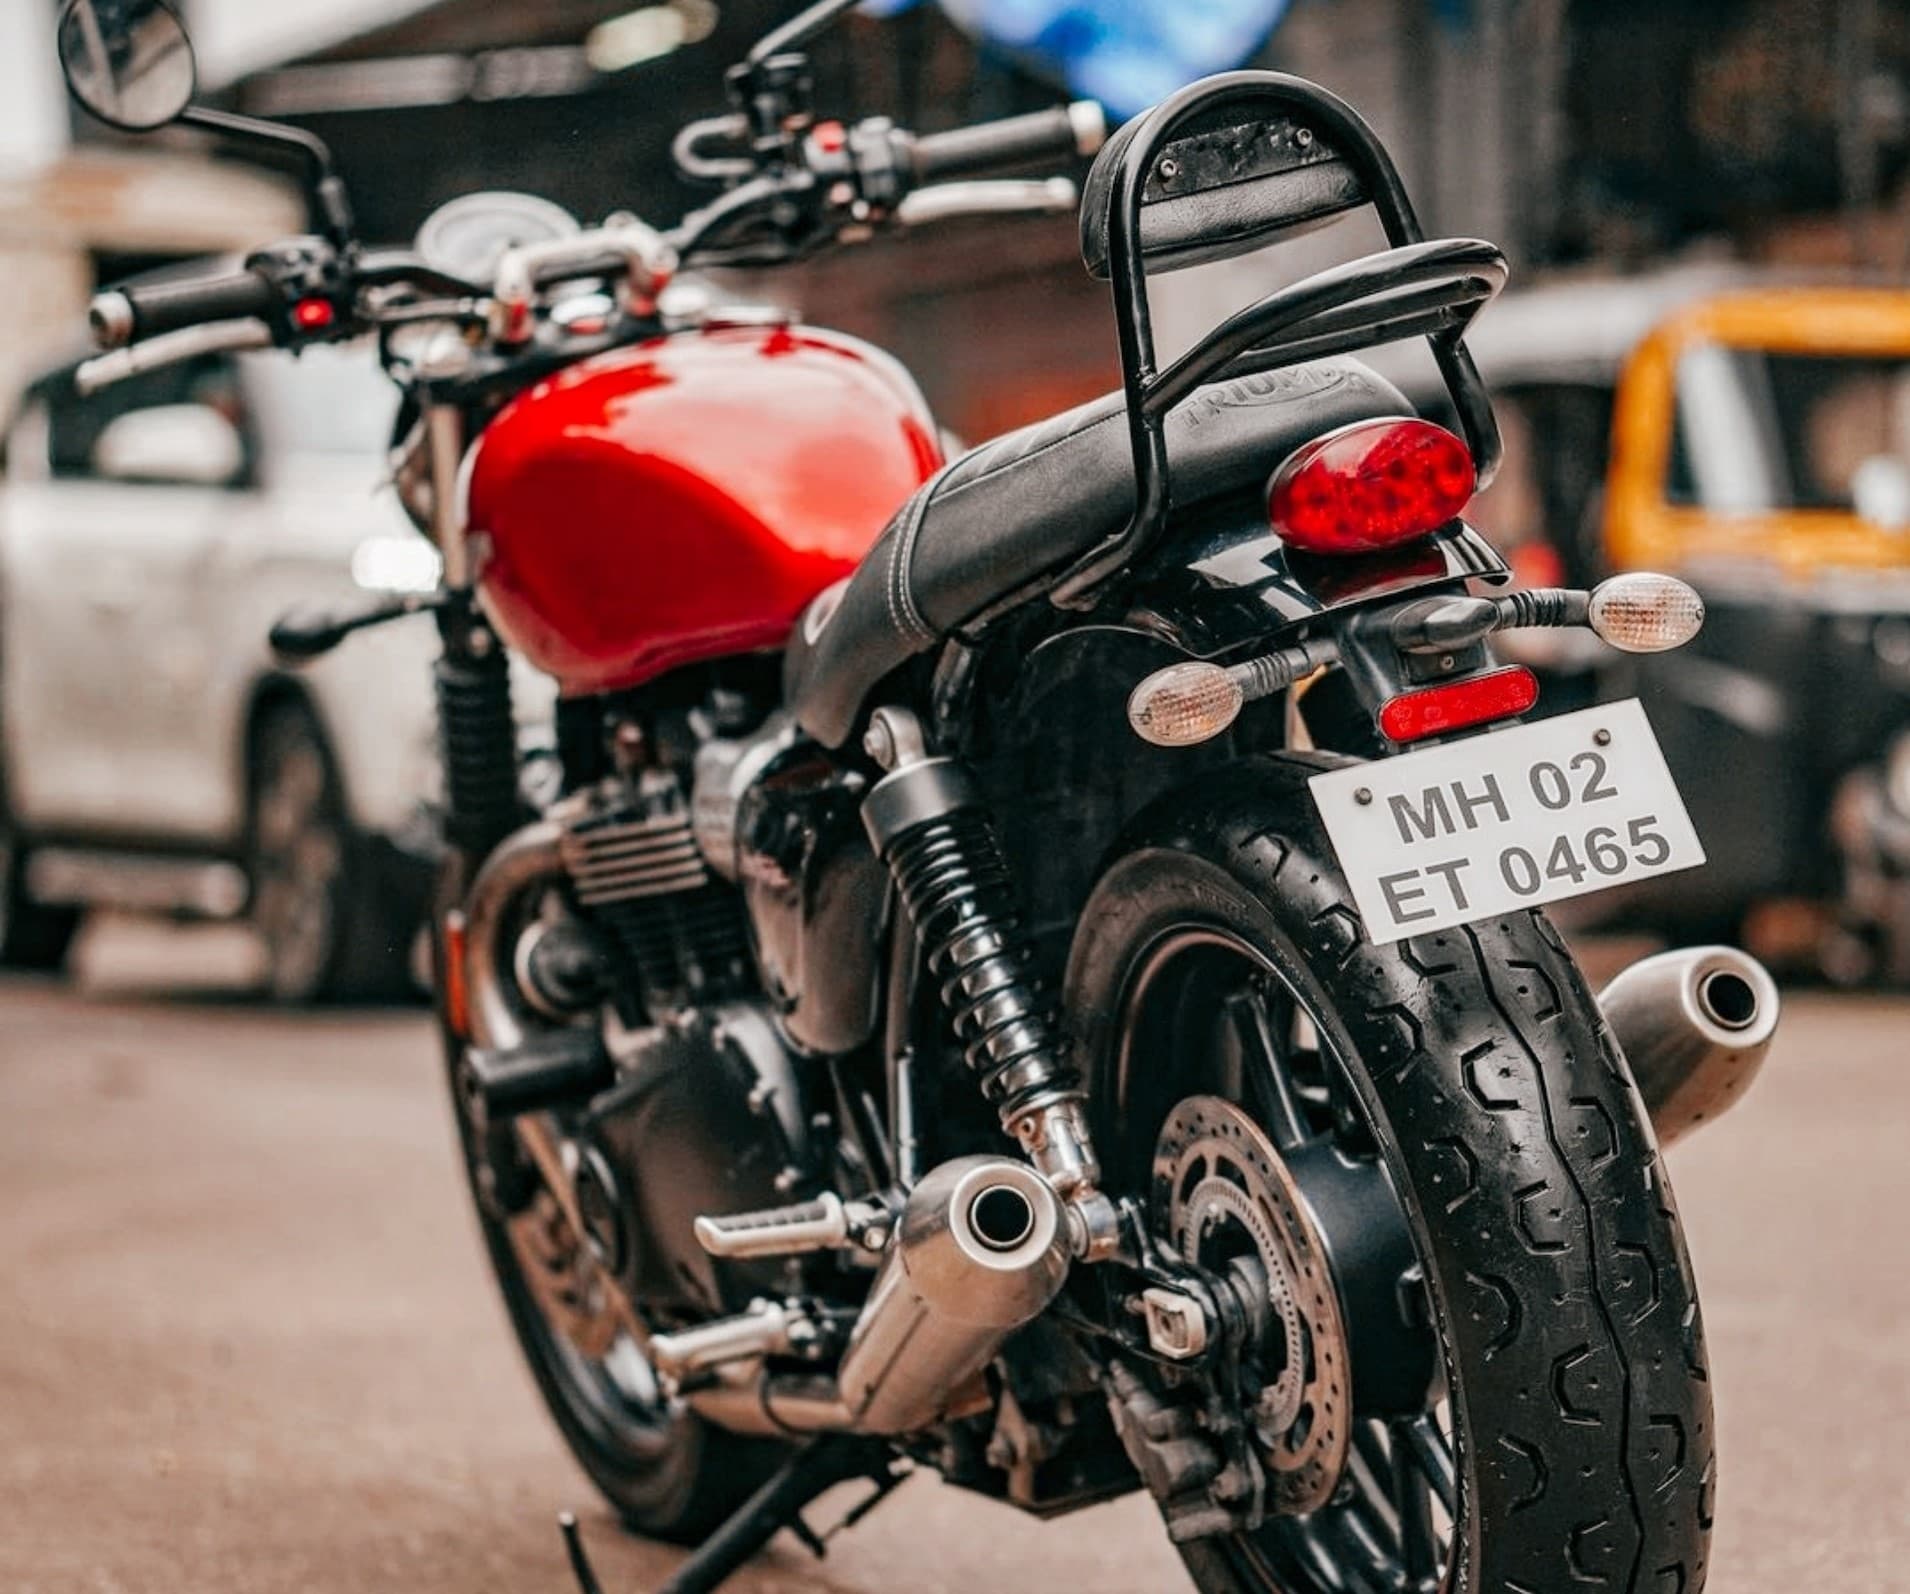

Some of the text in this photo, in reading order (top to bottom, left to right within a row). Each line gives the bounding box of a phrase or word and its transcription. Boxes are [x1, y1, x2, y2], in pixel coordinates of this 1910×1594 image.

[1387, 752, 1619, 844] MH 02
[1378, 816, 1671, 925] ET 0465
